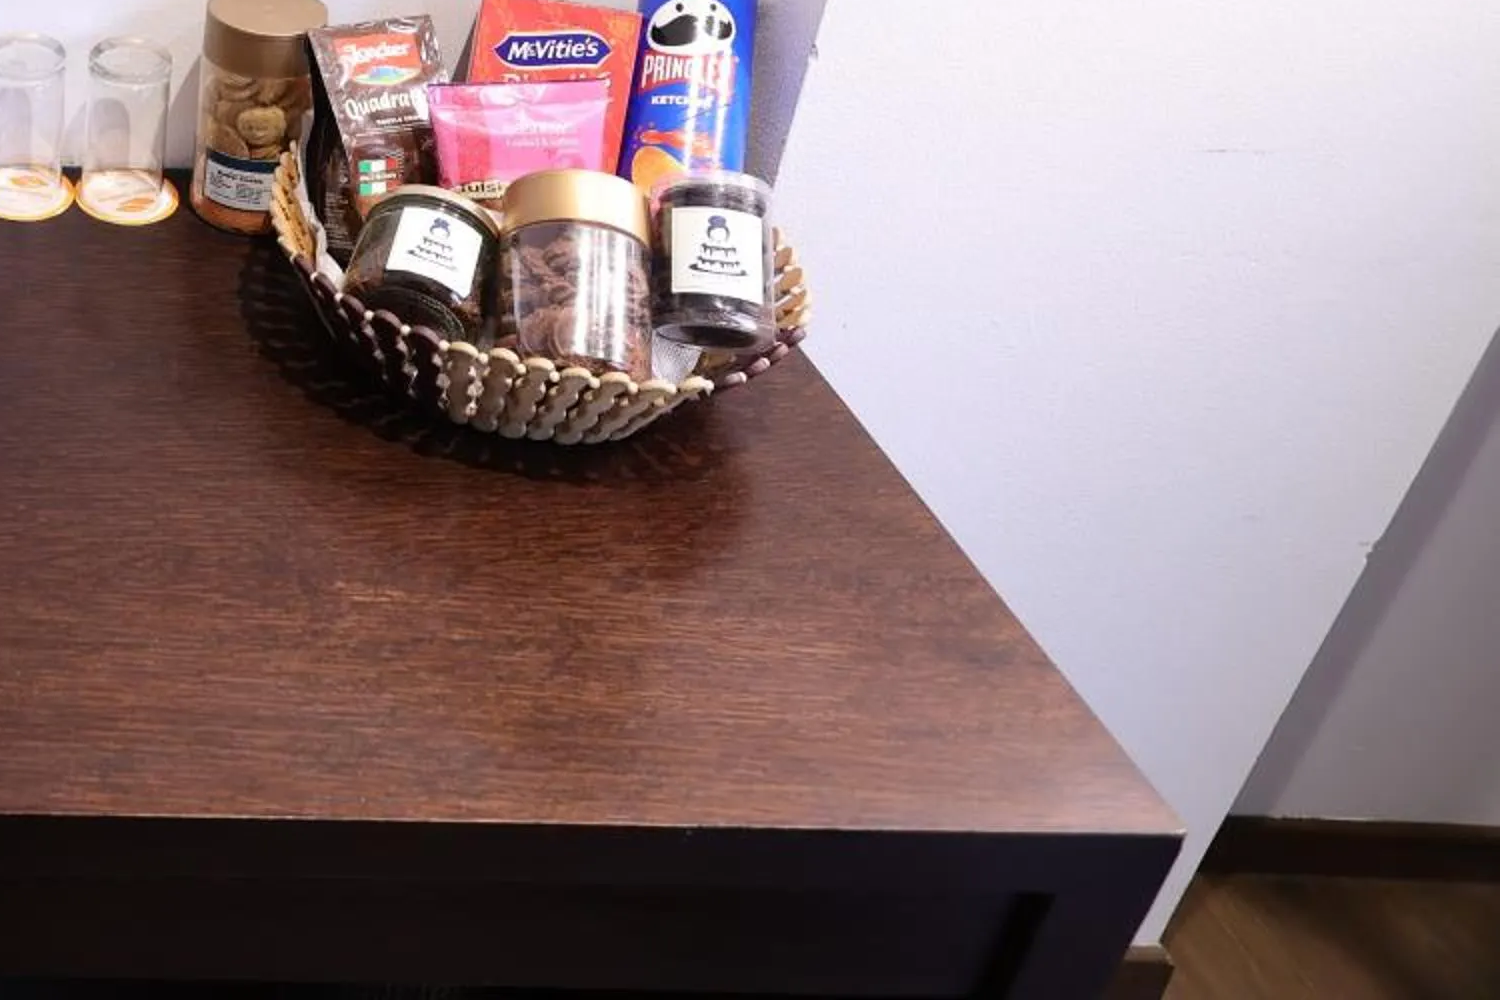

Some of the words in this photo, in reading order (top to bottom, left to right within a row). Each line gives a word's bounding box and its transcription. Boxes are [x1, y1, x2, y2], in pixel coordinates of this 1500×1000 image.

[507, 37, 599, 61] McVitie's
[641, 53, 733, 89] PRINGE
[651, 95, 715, 108] KETCHP
